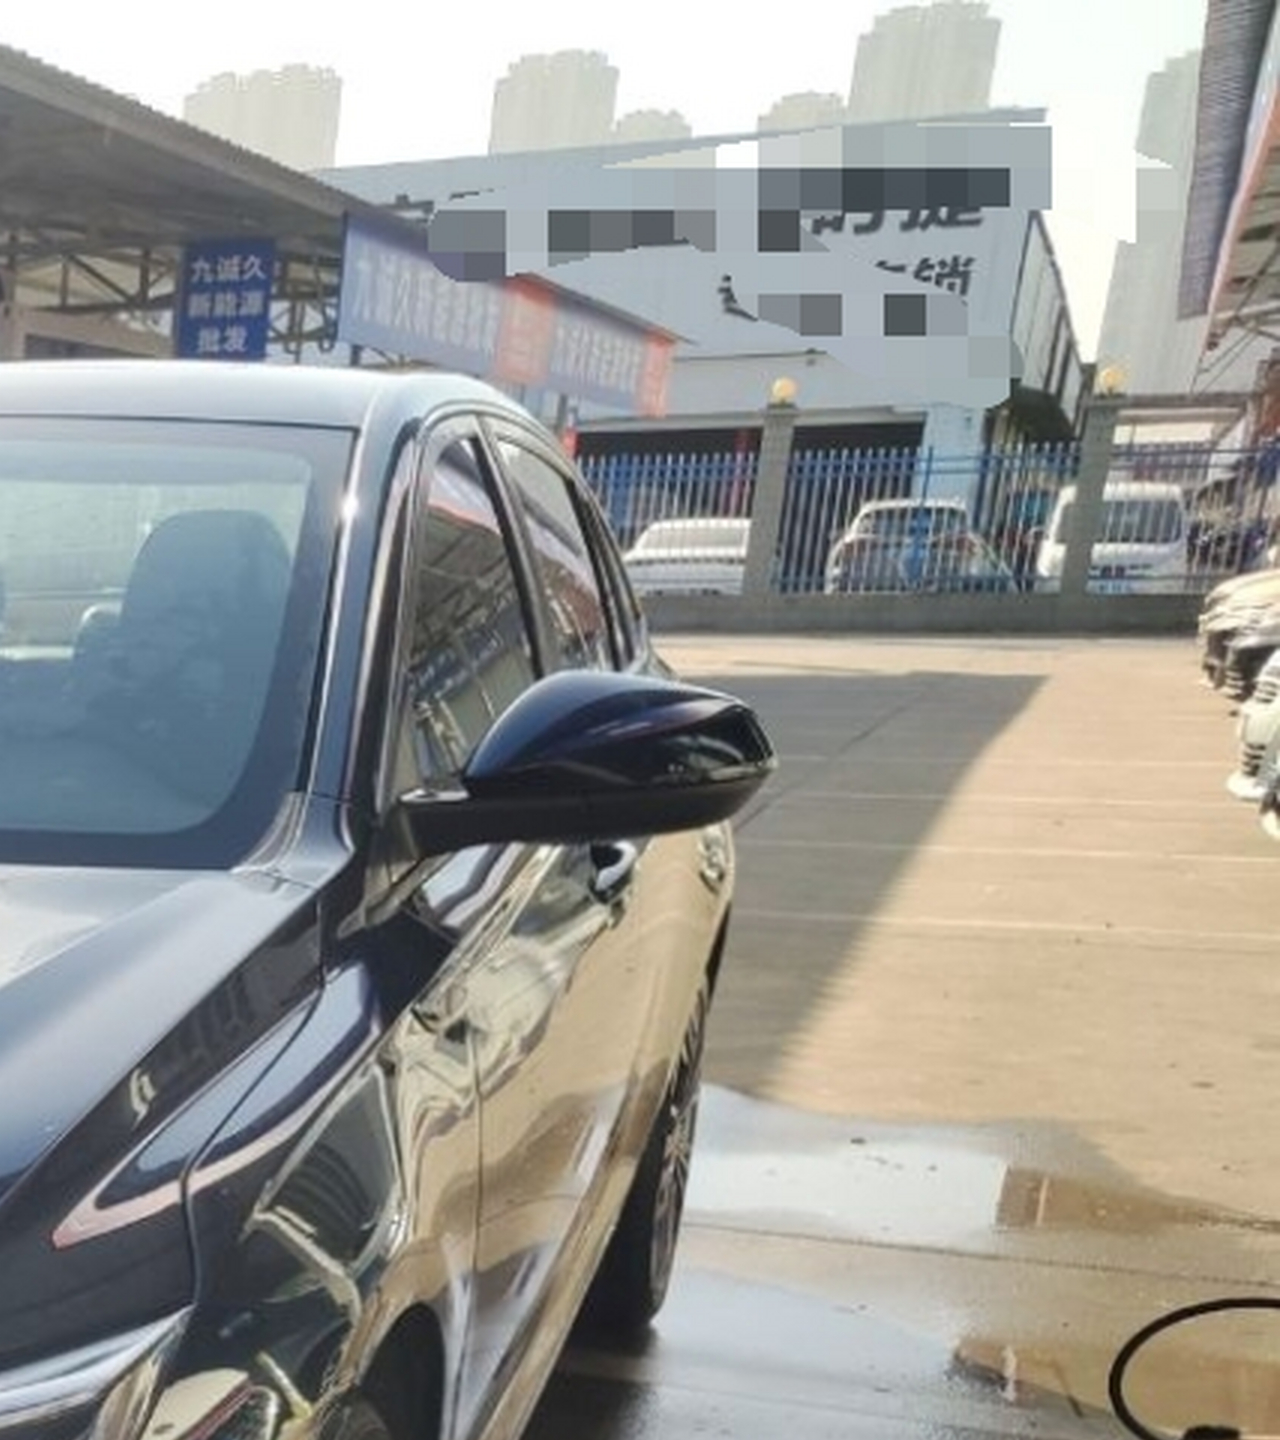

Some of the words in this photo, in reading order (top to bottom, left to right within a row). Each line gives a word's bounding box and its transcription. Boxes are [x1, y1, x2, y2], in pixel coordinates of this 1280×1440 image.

[188, 290, 264, 319] 新能源
[197, 324, 248, 353] 批发
